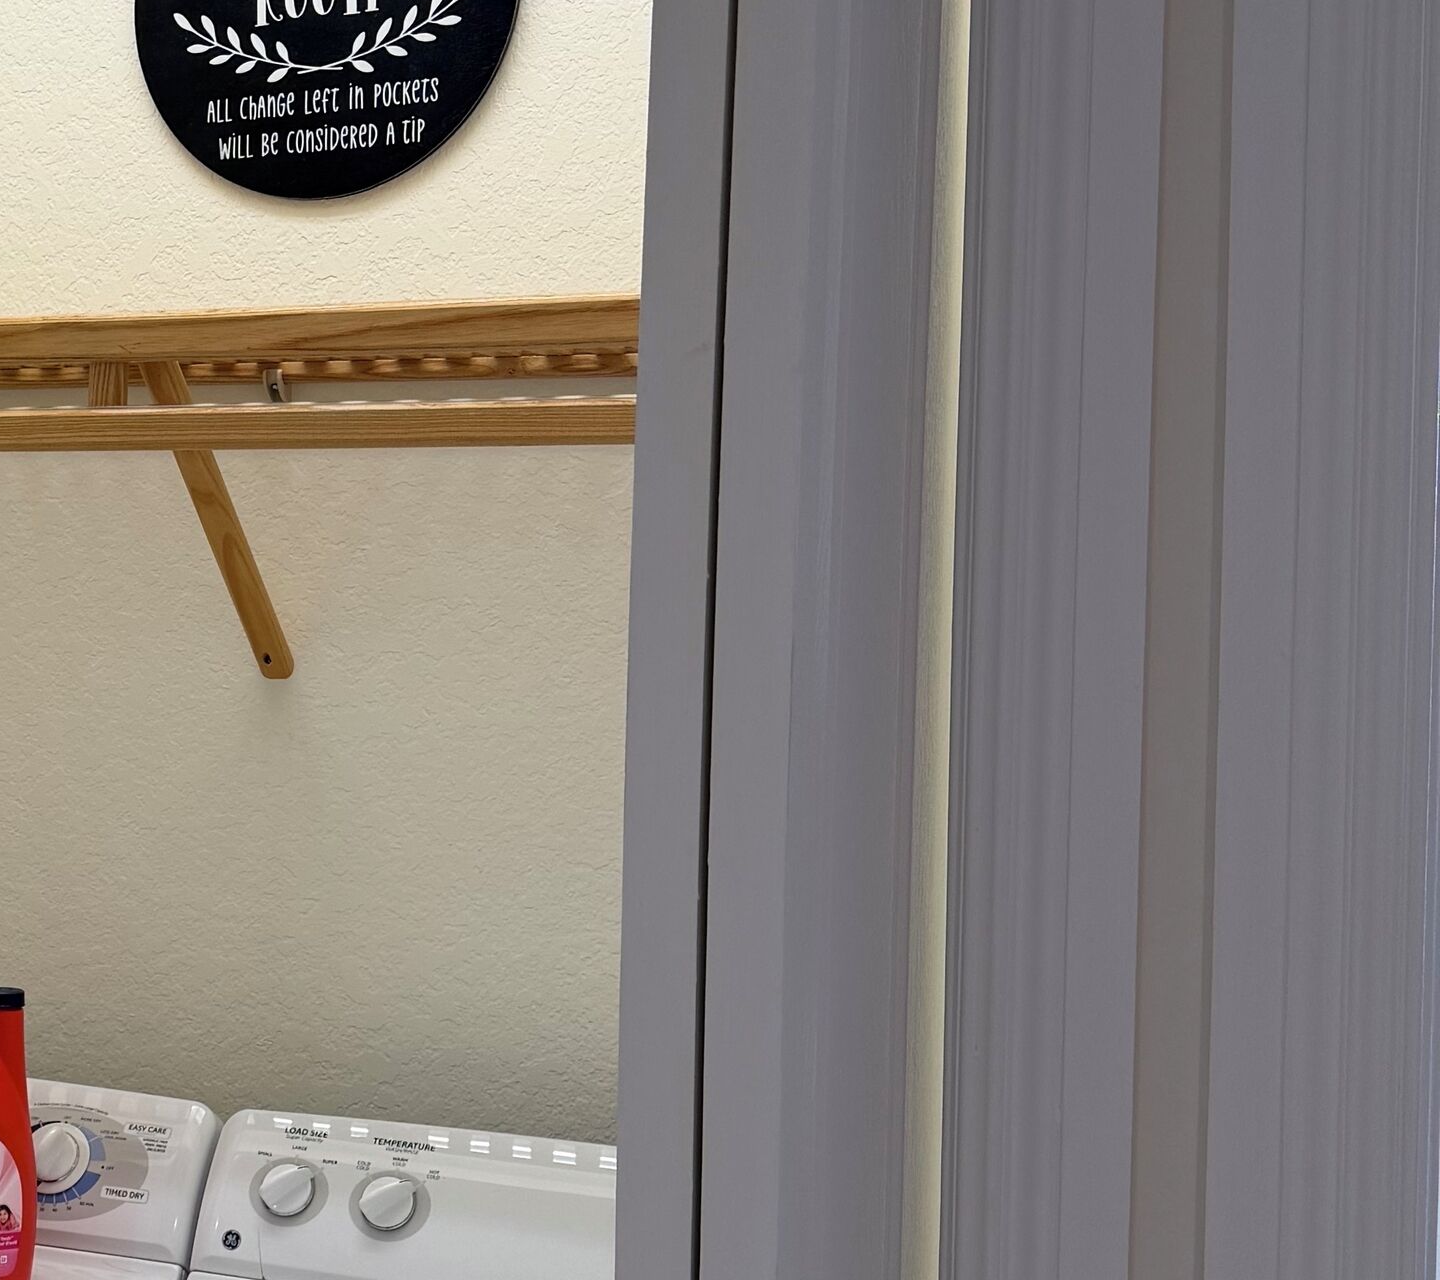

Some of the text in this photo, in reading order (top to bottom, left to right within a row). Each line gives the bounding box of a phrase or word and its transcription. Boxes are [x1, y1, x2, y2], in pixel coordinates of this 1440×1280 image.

[207, 98, 233, 123] ALL
[386, 121, 395, 146] A
[128, 1124, 167, 1135] EASY CARE
[284, 1127, 328, 1138] LOAD SIZE
[373, 1137, 436, 1152] TEMPERATURE
[105, 1188, 145, 1200] TIMED DRY
